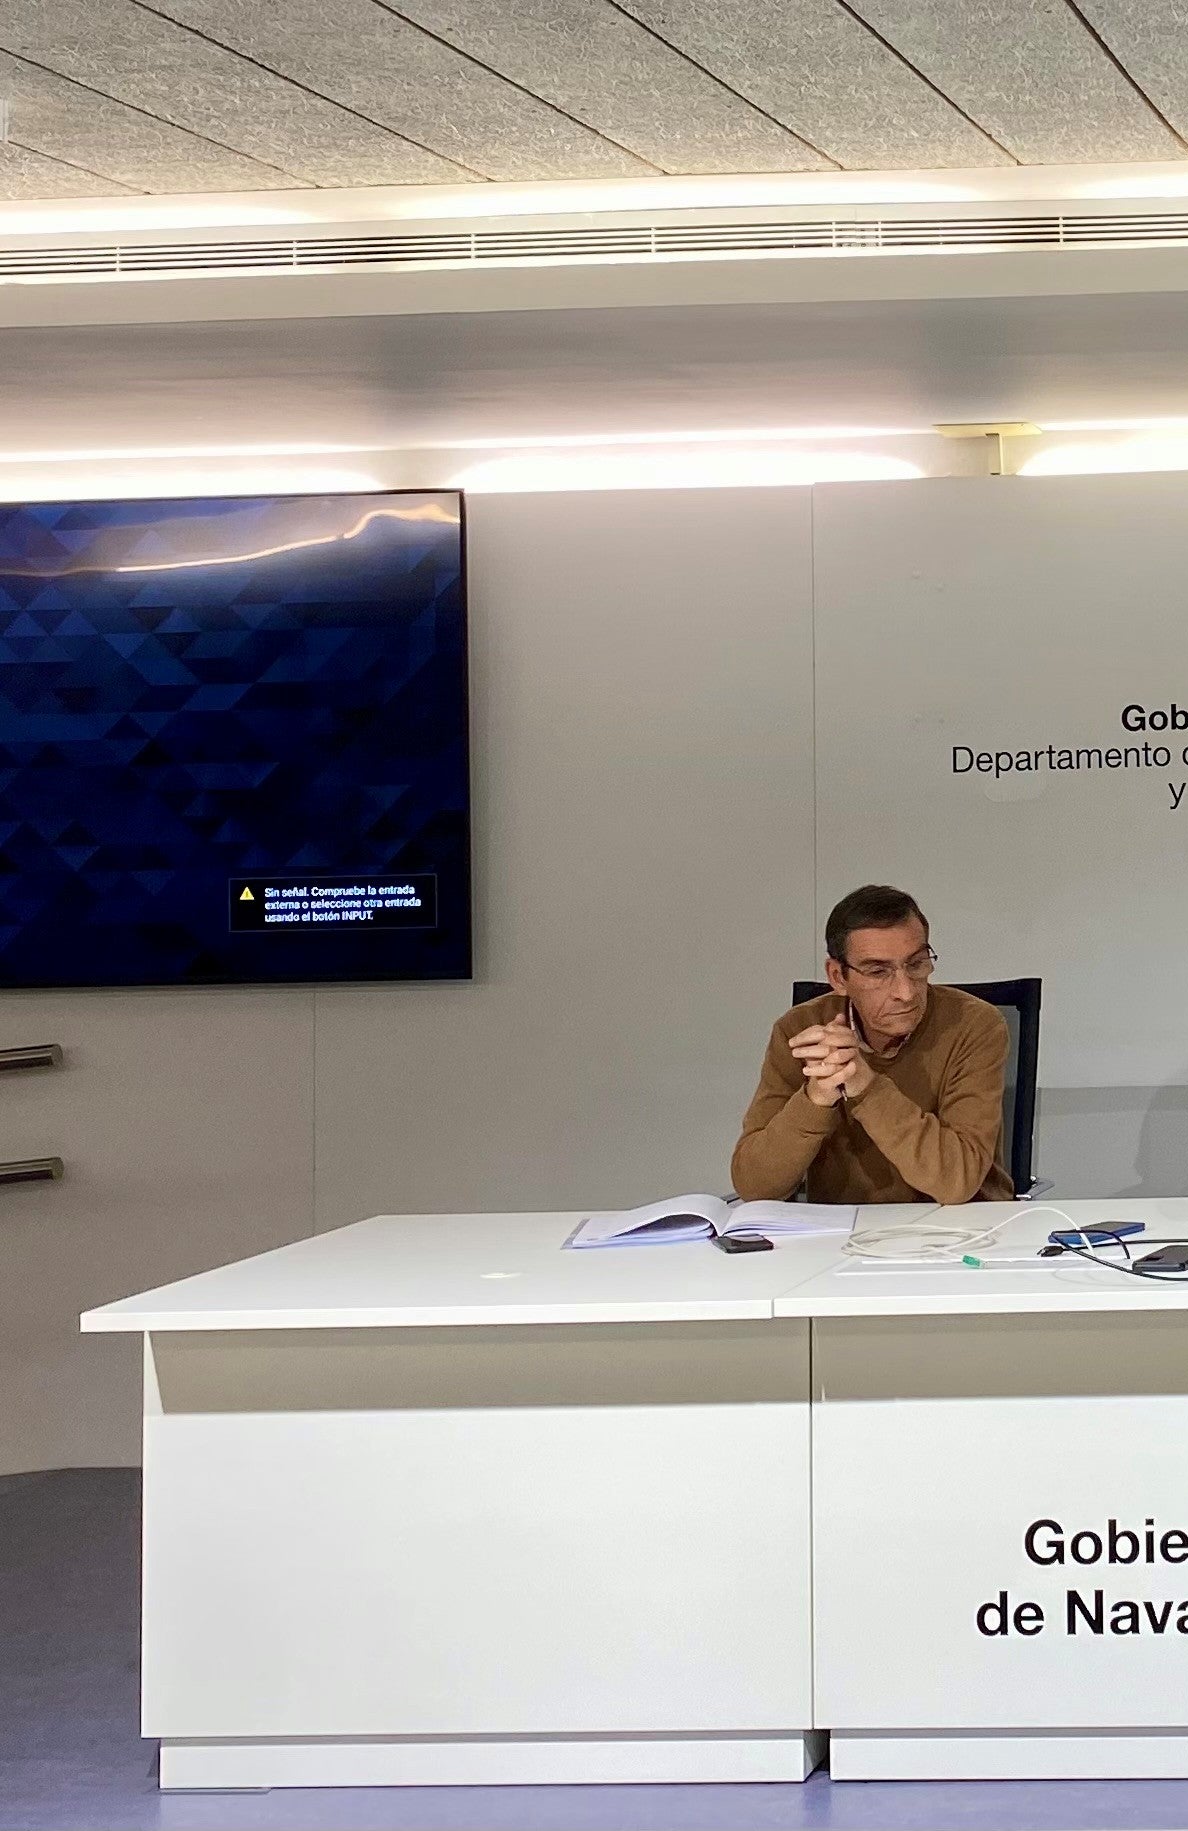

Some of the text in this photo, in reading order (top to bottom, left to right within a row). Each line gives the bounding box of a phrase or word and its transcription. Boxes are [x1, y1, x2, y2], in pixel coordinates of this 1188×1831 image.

[952, 744, 1171, 779] Departamento
[1167, 782, 1187, 810] y
[265, 885, 416, 898] Sin señal. Compruebe la entrada
[265, 901, 300, 909] externa
[311, 899, 362, 909] seleccione
[385, 897, 422, 907] entrada
[265, 910, 374, 922] usando el botón INPUT.
[976, 1590, 1045, 1637] de
